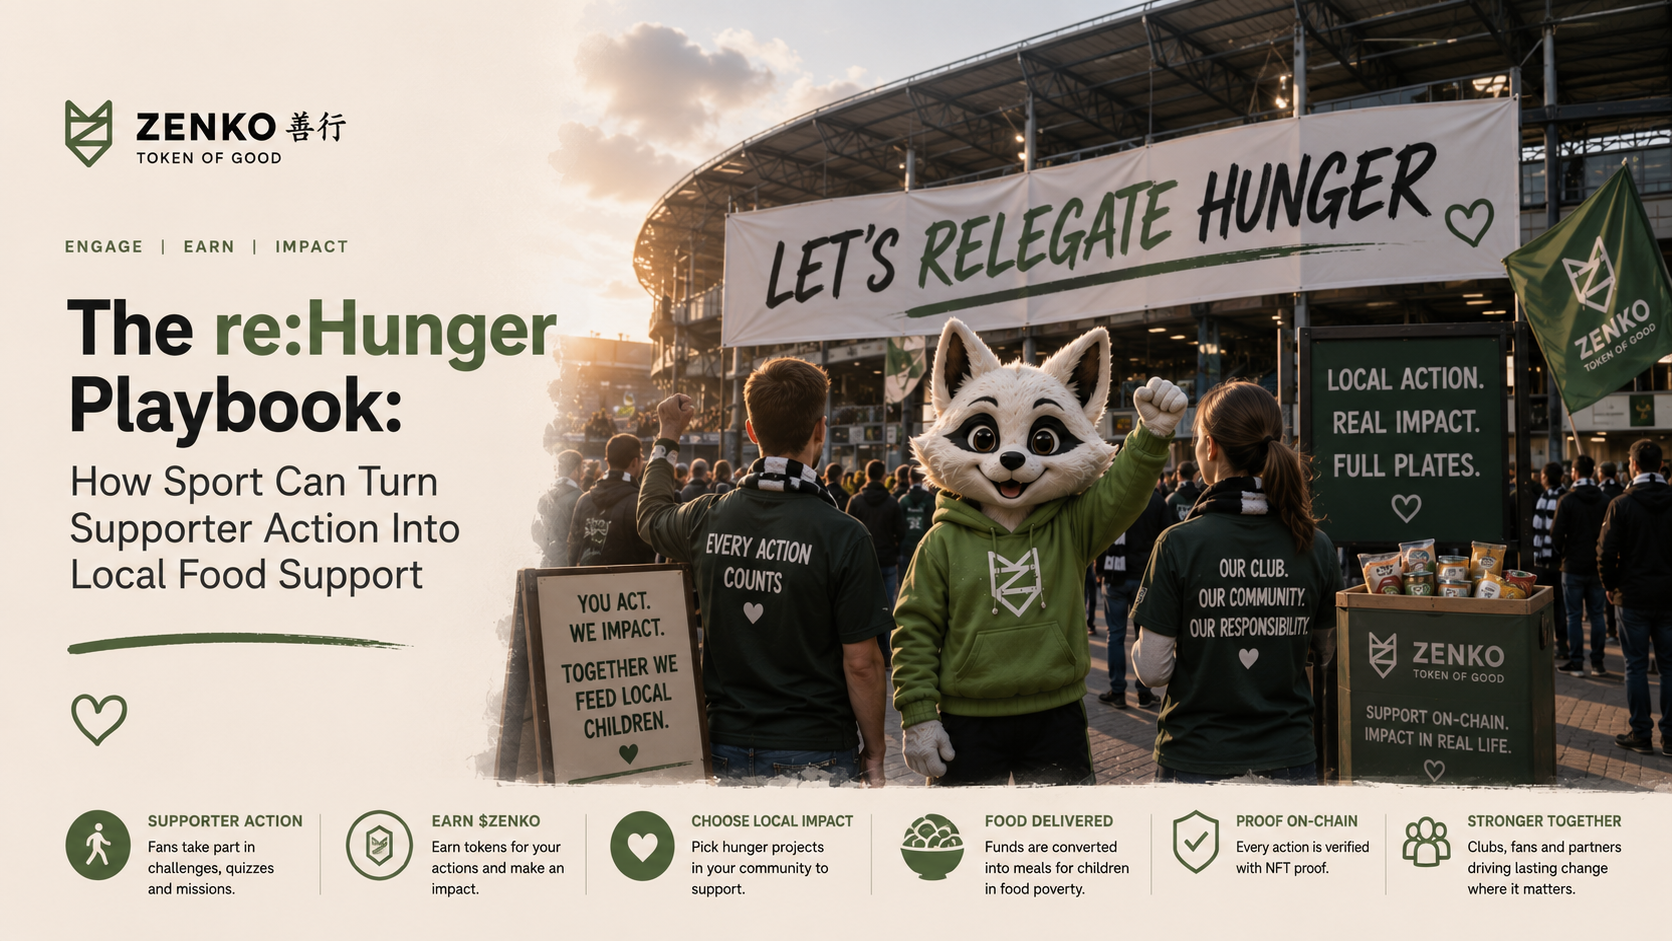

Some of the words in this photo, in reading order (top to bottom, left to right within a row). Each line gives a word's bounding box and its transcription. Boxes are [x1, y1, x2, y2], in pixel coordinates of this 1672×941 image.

[766, 223, 899, 309] LET'S
[918, 179, 1179, 289] RELEGATE
[1197, 142, 1437, 244] HUNGER
[1574, 299, 1650, 361] ZENKO
[1584, 350, 1614, 372] TOKEN
[1614, 339, 1629, 355] OF
[1629, 323, 1656, 345] GOOD
[1328, 368, 1392, 391] LOCAL
[1401, 367, 1484, 390] ACTION.
[1334, 411, 1387, 434] REAL
[1397, 410, 1479, 433] IMPACT.
[1334, 454, 1385, 477] FULL
[1395, 453, 1480, 477] PLATES.
[706, 533, 753, 557] EVERY
[756, 538, 812, 565] ACTION
[724, 567, 782, 593] COUNTS
[1219, 558, 1246, 578] OUR
[1250, 558, 1289, 578] CLUB.
[576, 593, 611, 614] YOU
[617, 591, 650, 611] ACT.
[1198, 587, 1226, 608] OUR
[1229, 587, 1306, 607] COMMUNITY.
[568, 622, 597, 643] WE
[602, 618, 664, 640] IMPACT.
[1189, 617, 1216, 638] OUR
[1221, 617, 1309, 637] RESPONSIBILITY.
[1413, 642, 1504, 667] ZENKO
[561, 657, 648, 683] TOGETHER
[652, 653, 679, 674] WE
[1412, 668, 1449, 680] TOKEN
[1452, 671, 1468, 681] OF
[1470, 672, 1505, 684] GOOD
[576, 689, 616, 711] FEED
[622, 683, 672, 705] LOCAL
[584, 711, 669, 739] CHILDREN.
[1366, 704, 1429, 724] SUPPORT
[1432, 710, 1509, 731] ON-CHAIN.
[1364, 726, 1415, 746] IMPACT
[1418, 731, 1433, 748] IN
[1437, 733, 1474, 751] REAL
[1478, 736, 1512, 754] LIFE.
